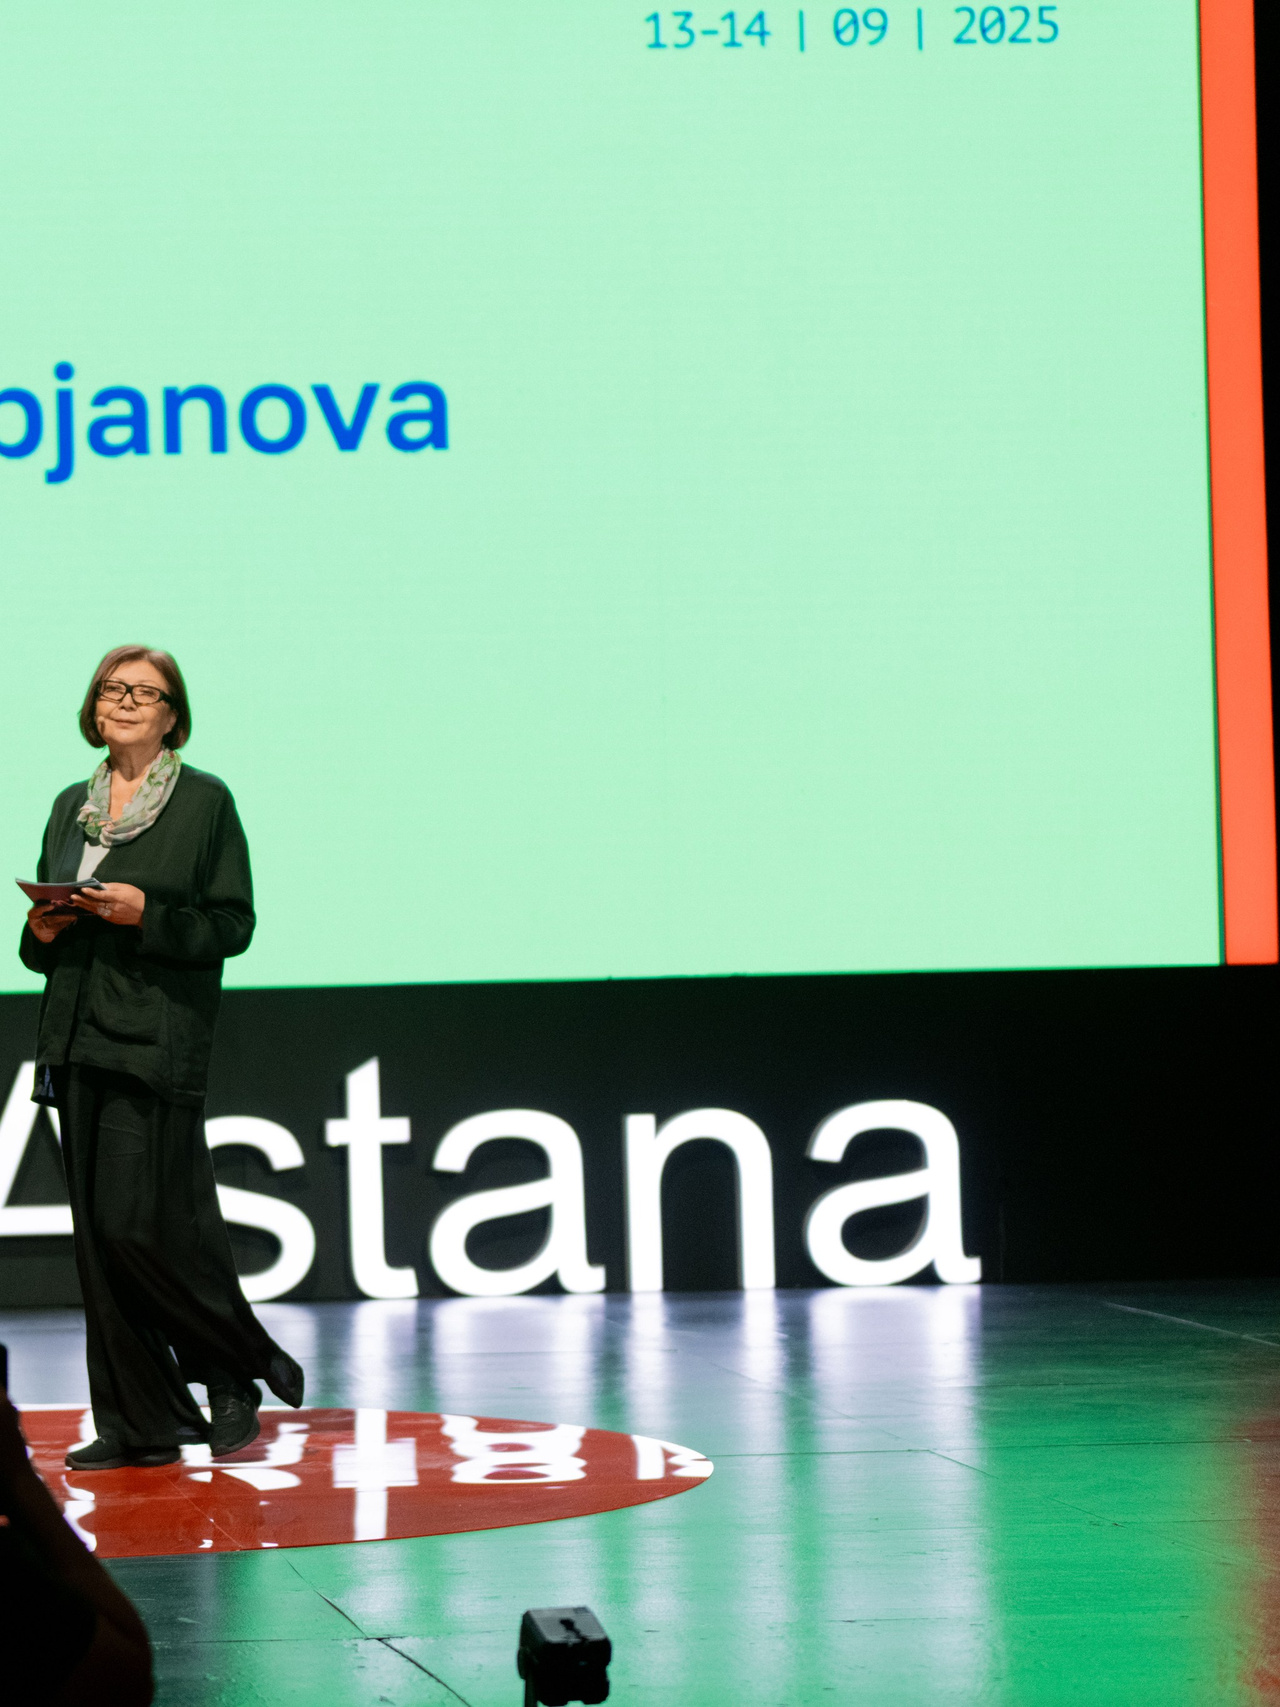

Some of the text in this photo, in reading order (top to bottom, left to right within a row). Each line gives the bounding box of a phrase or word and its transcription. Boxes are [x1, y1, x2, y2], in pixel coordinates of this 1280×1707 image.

[644, 10, 772, 50] 13-14
[832, 7, 889, 47] 09
[953, 5, 1060, 46] 2025
